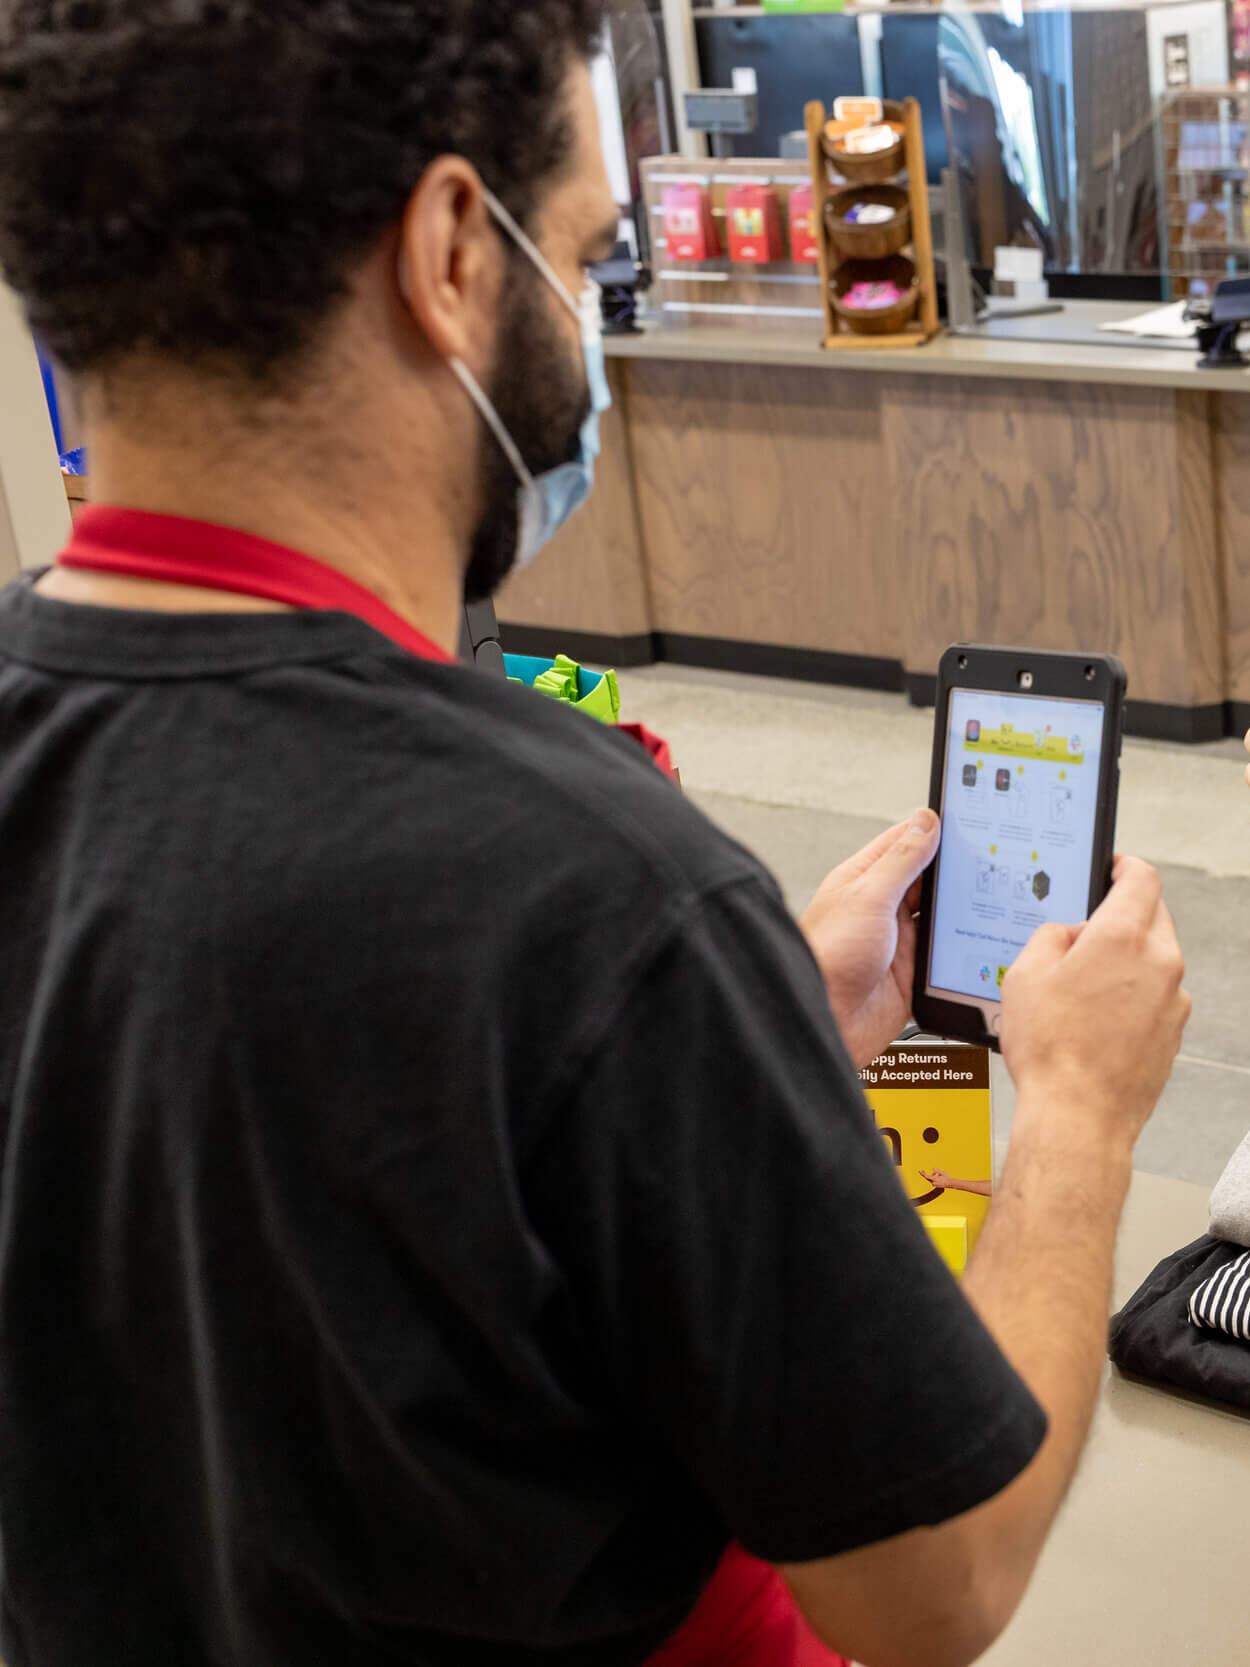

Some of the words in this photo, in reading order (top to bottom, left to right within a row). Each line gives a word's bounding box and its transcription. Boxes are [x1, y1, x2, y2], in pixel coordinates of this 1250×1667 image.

[871, 1054, 895, 1066] ppy
[898, 1053, 948, 1064] Returns
[880, 1069, 940, 1083] Accepted
[943, 1069, 974, 1080] Here
